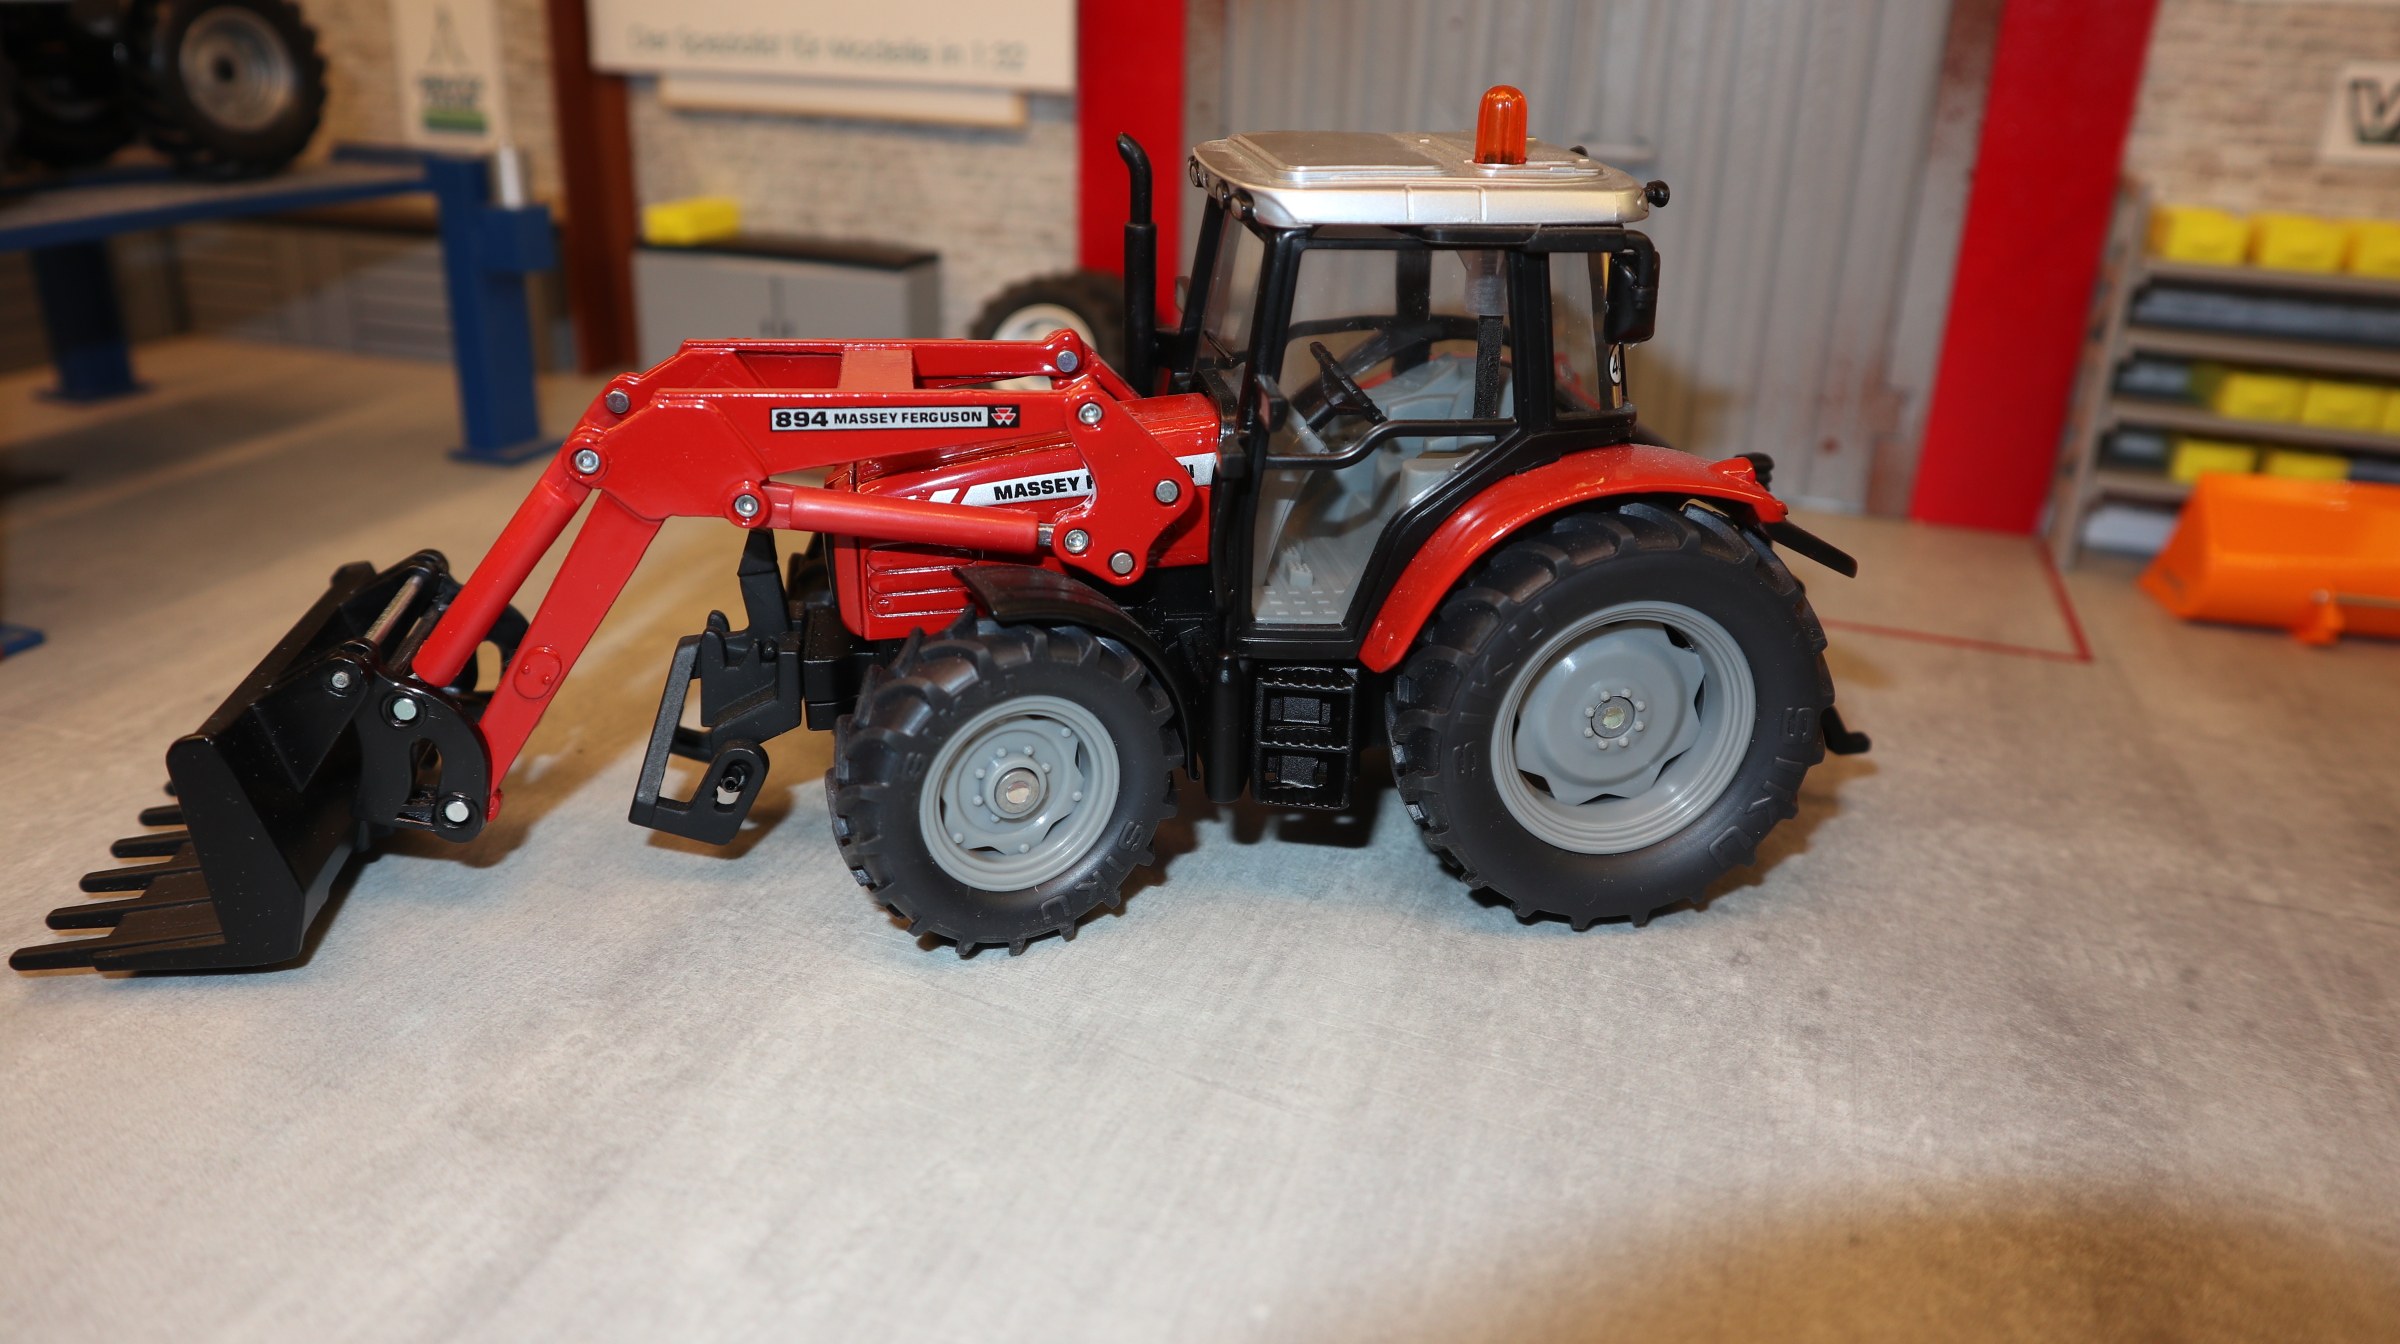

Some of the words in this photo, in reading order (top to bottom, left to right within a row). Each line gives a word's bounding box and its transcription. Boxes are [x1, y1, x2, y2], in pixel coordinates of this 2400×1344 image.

[775, 411, 828, 427] 894
[833, 411, 898, 425] MASSEY
[901, 410, 982, 424] FERGUSON
[993, 475, 1081, 501] MASSEY
[1708, 705, 1816, 870] SIKU
[1040, 819, 1146, 925] SIKU
